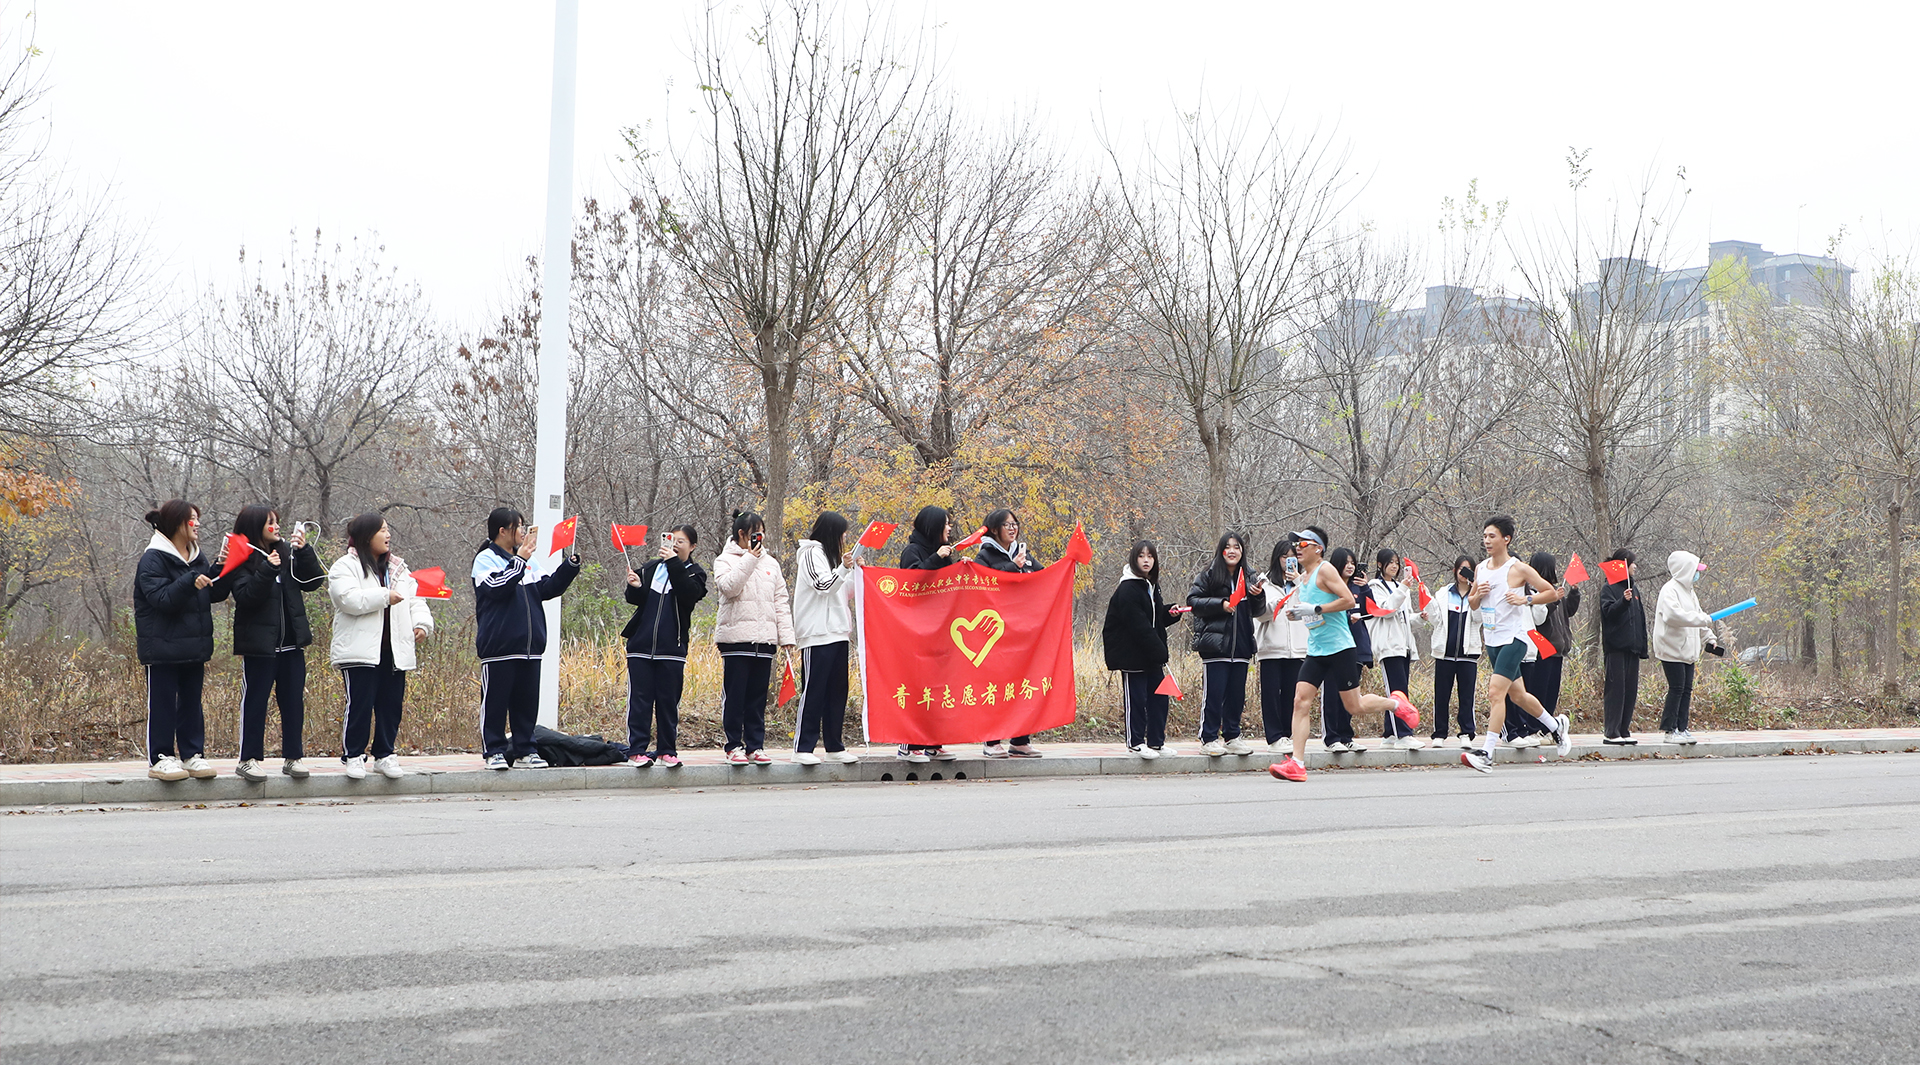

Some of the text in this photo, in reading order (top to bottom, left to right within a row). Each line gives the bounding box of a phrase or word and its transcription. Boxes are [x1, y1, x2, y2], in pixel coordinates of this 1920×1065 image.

[892, 676, 1053, 711] 青年志愿者服务队
